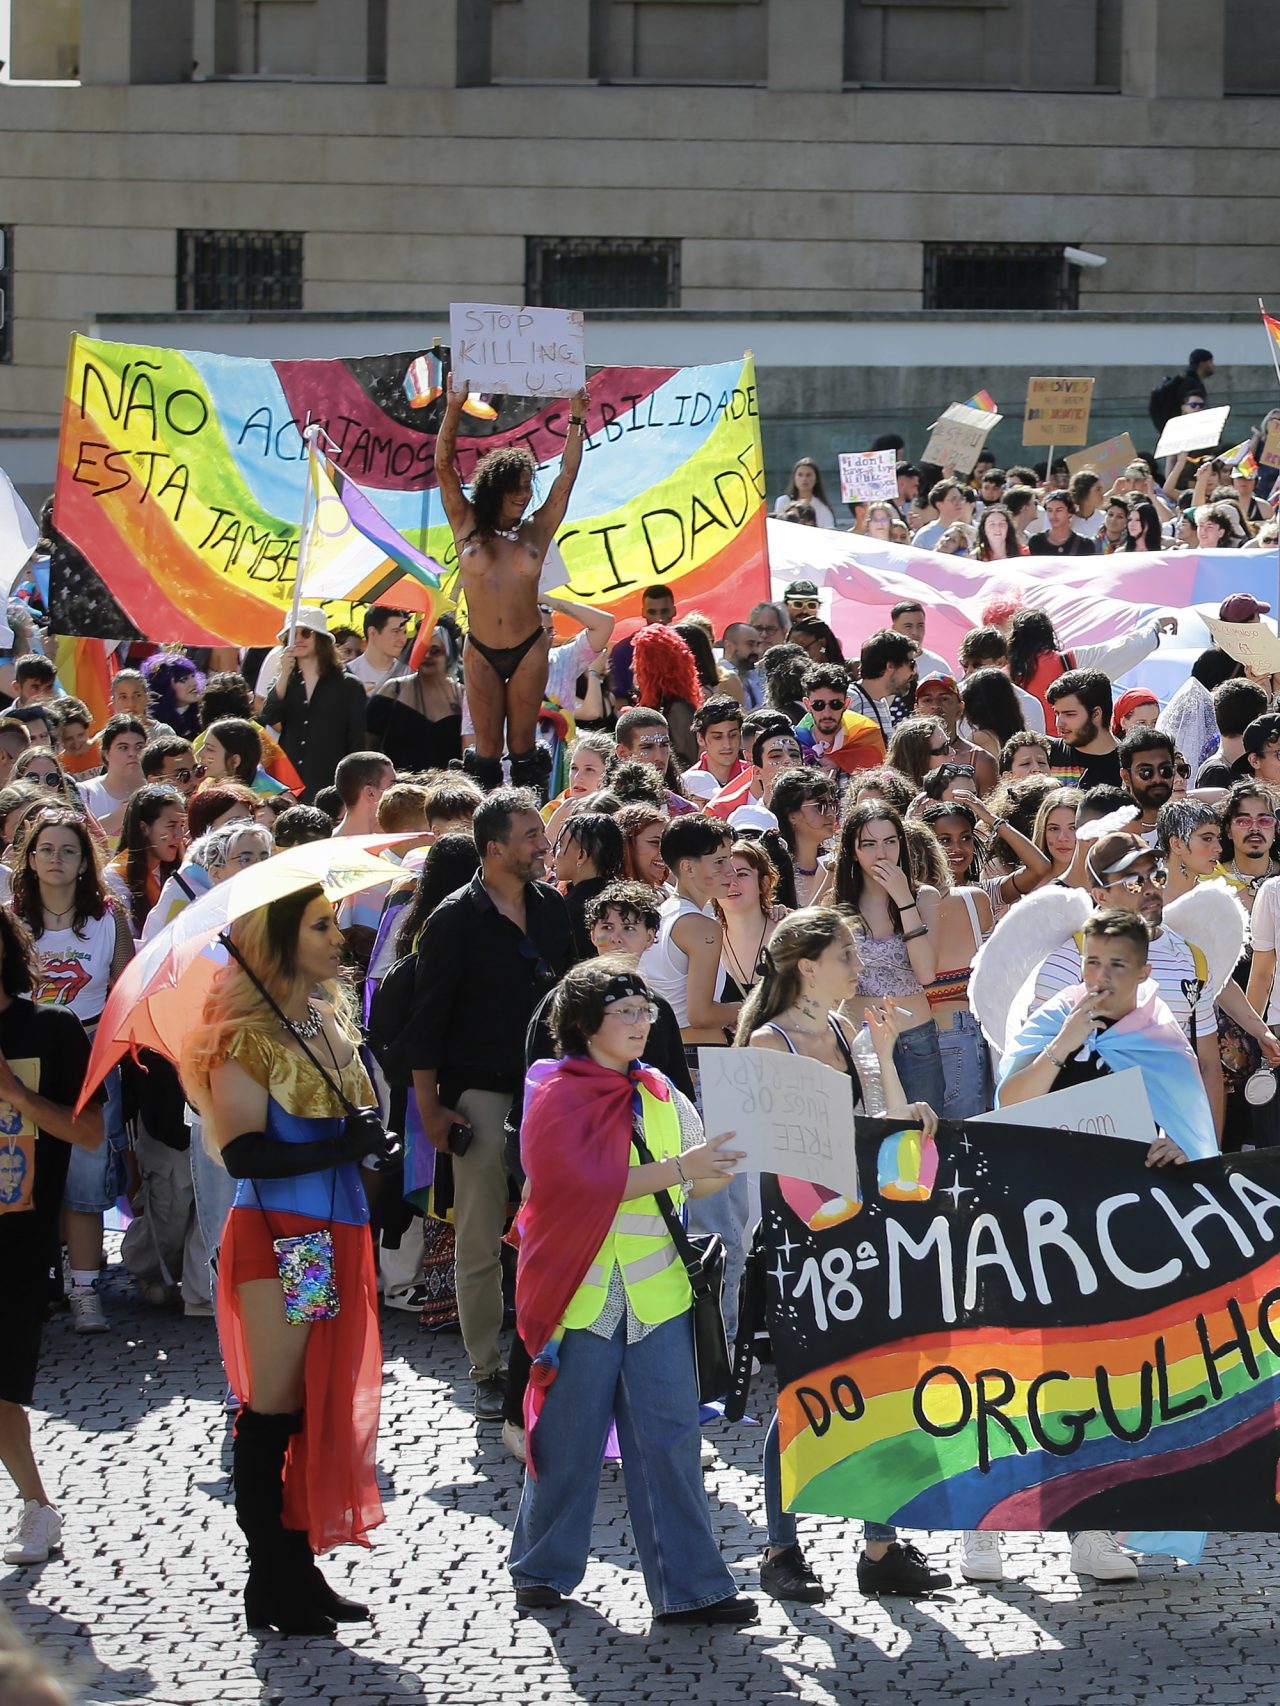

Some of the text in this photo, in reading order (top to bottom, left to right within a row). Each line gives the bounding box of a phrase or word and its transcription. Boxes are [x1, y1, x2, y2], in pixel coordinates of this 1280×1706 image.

[464, 310, 534, 337] STOP
[459, 339, 574, 365] KILLING
[80, 360, 209, 441] NÃO
[72, 442, 189, 521] ESTA
[556, 443, 767, 597] CIDADE
[771, 1122, 834, 1161] FREE
[795, 1374, 866, 1438] DO
